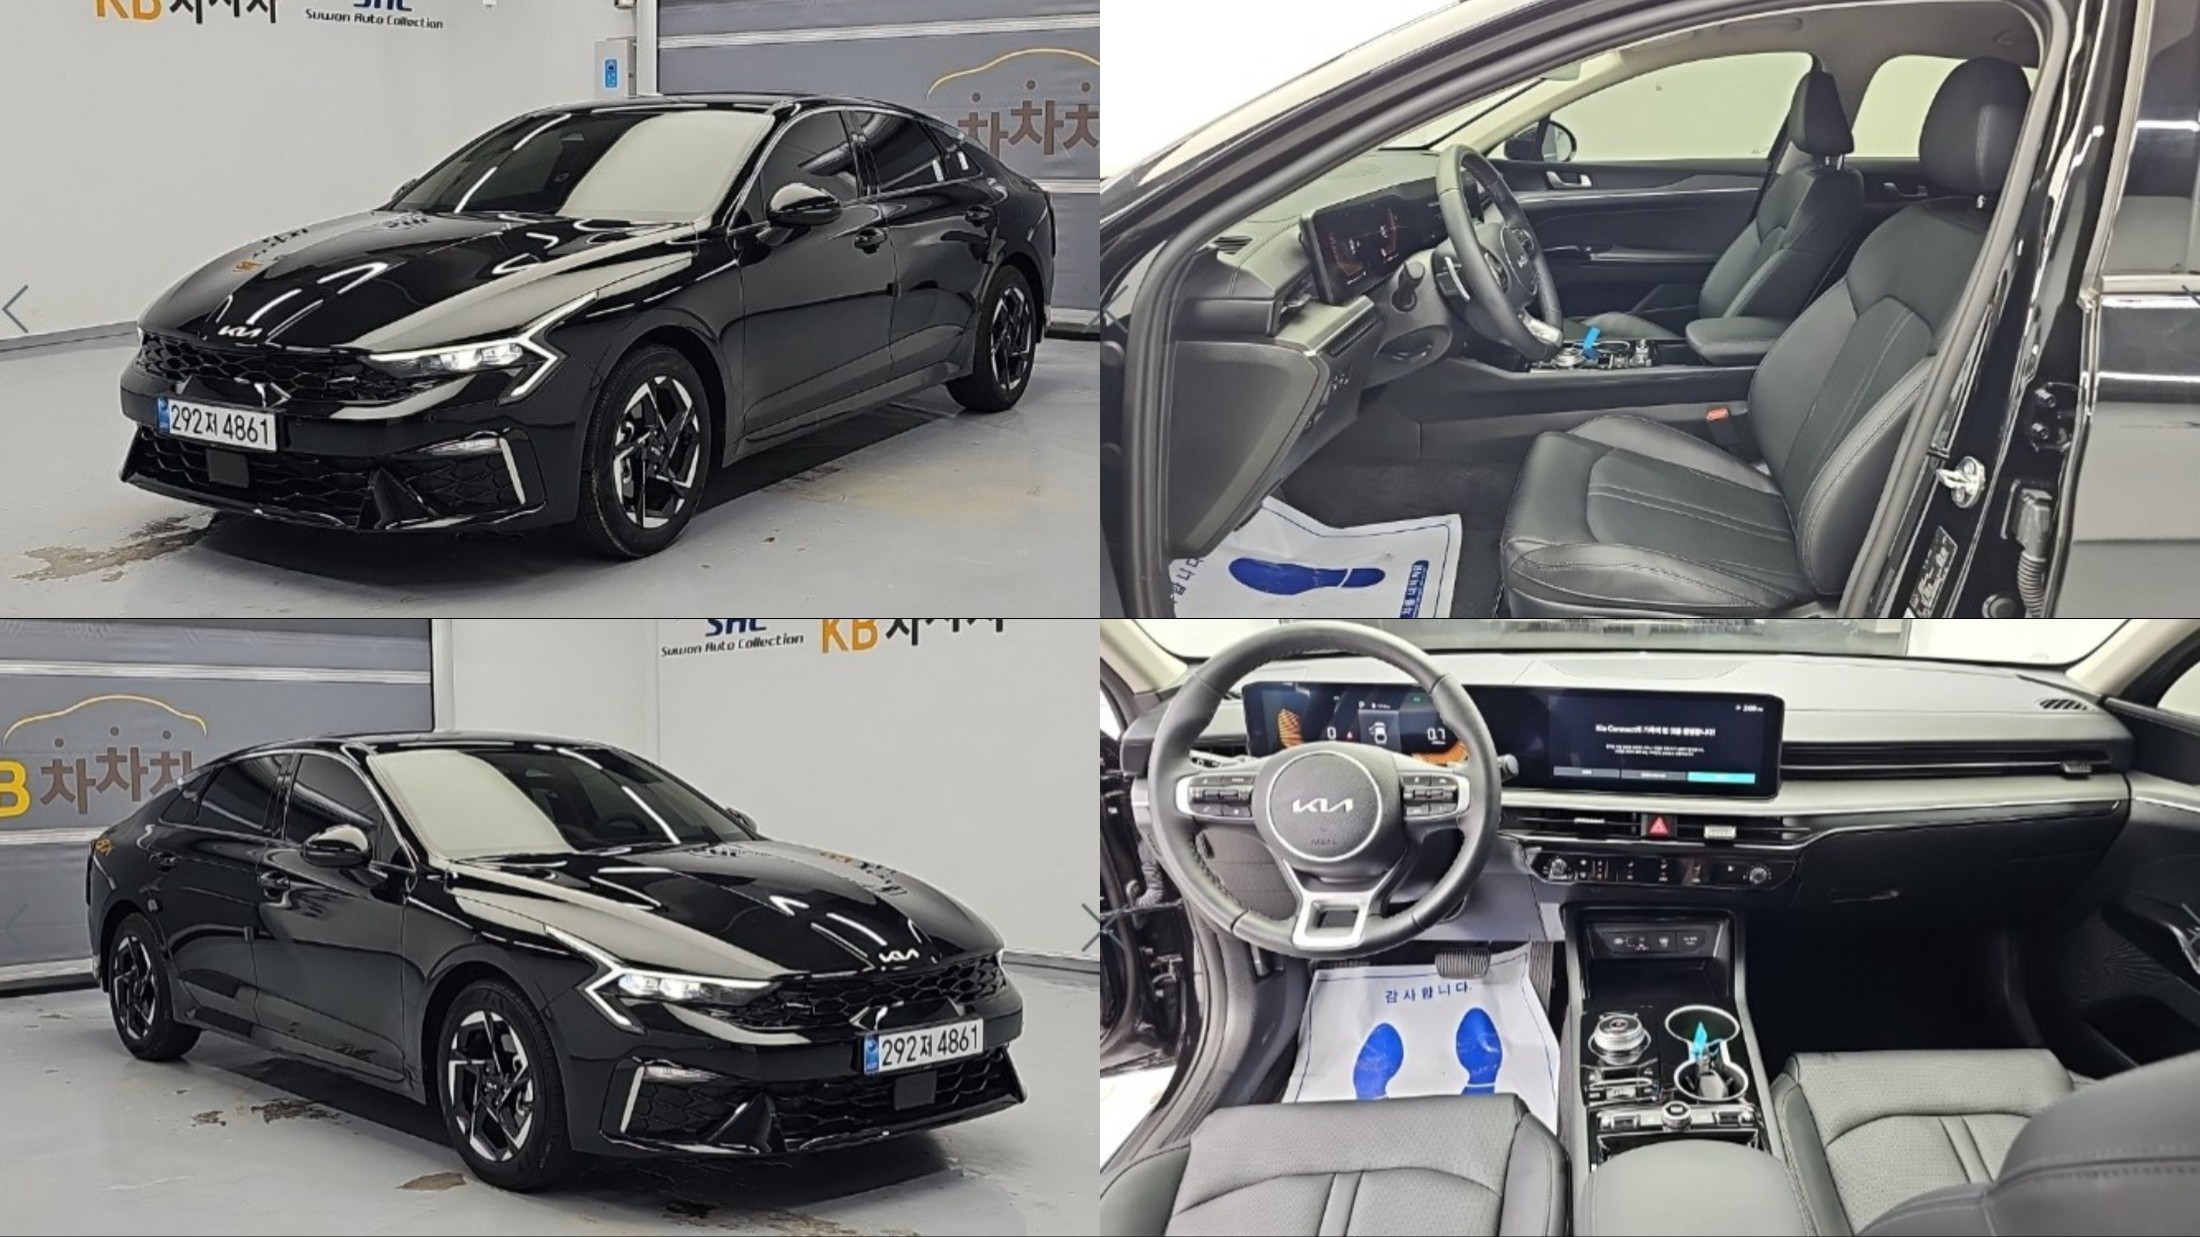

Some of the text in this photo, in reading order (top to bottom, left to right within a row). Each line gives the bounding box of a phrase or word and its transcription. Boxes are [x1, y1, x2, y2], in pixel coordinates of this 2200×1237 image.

[305, 8, 444, 29] Suwon Auto Collection
[223, 413, 268, 445] 4861
[661, 645, 702, 657] Suwon
[738, 632, 804, 649] Collection
[1293, 798, 1353, 813] KIA
[937, 1024, 978, 1056] 4861
